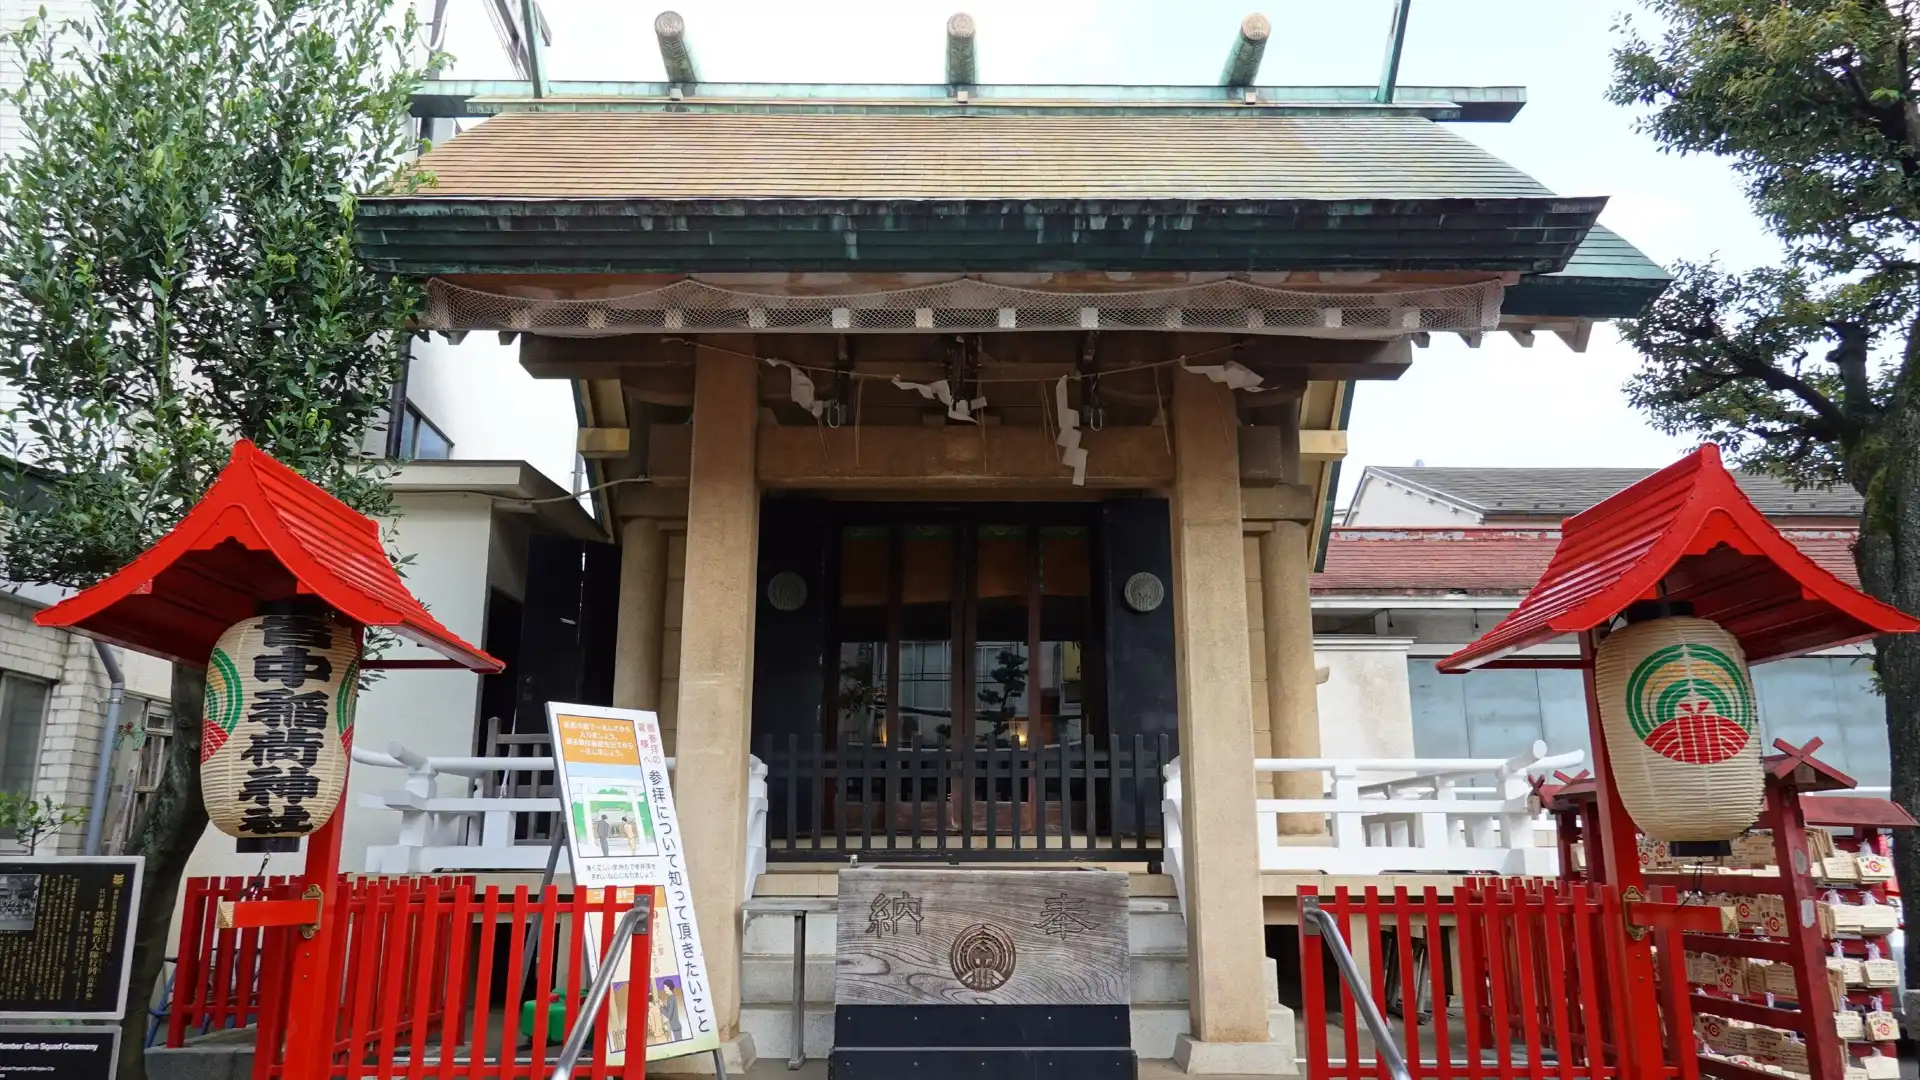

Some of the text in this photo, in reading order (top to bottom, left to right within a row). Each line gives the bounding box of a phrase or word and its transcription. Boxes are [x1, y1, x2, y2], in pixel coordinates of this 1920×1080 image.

[238, 615, 333, 835] 皆中稲荷神社
[648, 769, 710, 1034] 参拝について知って頂きたいこと
[865, 891, 1101, 941] 奉 納
[24, 1042, 39, 1050] Gun
[40, 1042, 62, 1052] Squad
[63, 1042, 99, 1052] Ceremony
